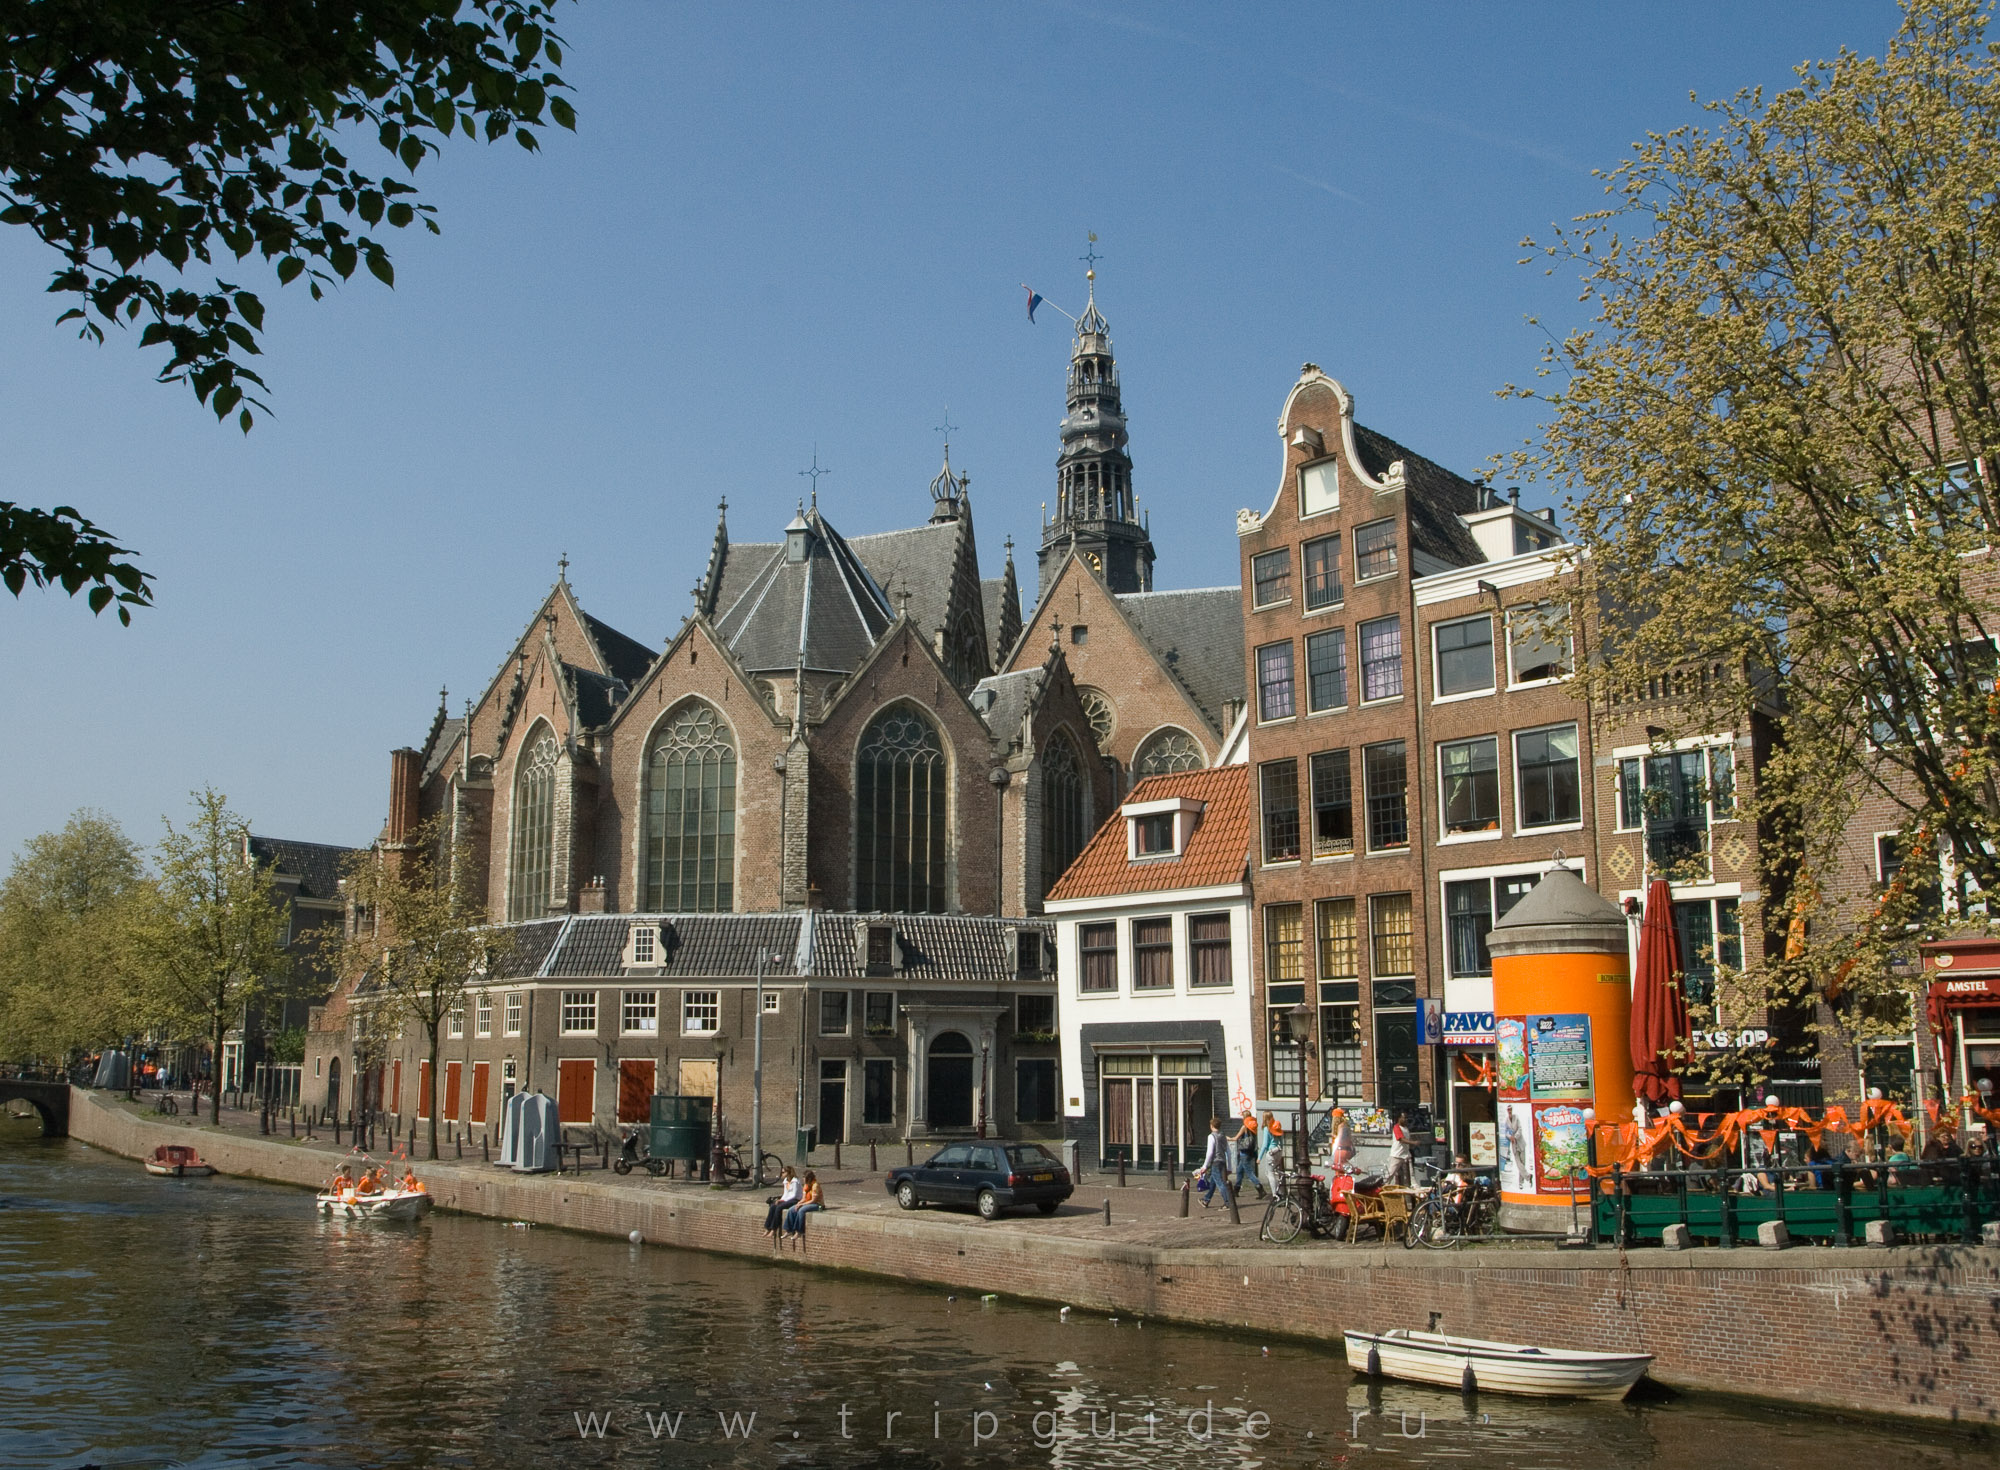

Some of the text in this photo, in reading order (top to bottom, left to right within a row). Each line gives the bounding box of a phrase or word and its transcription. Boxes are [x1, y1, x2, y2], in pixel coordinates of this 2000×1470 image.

[1946, 981, 1988, 992] AMSTEL
[1443, 1013, 1495, 1031] FAVO
[1444, 1036, 1495, 1044] CHICKE
[1553, 1114, 1579, 1126] PARK
